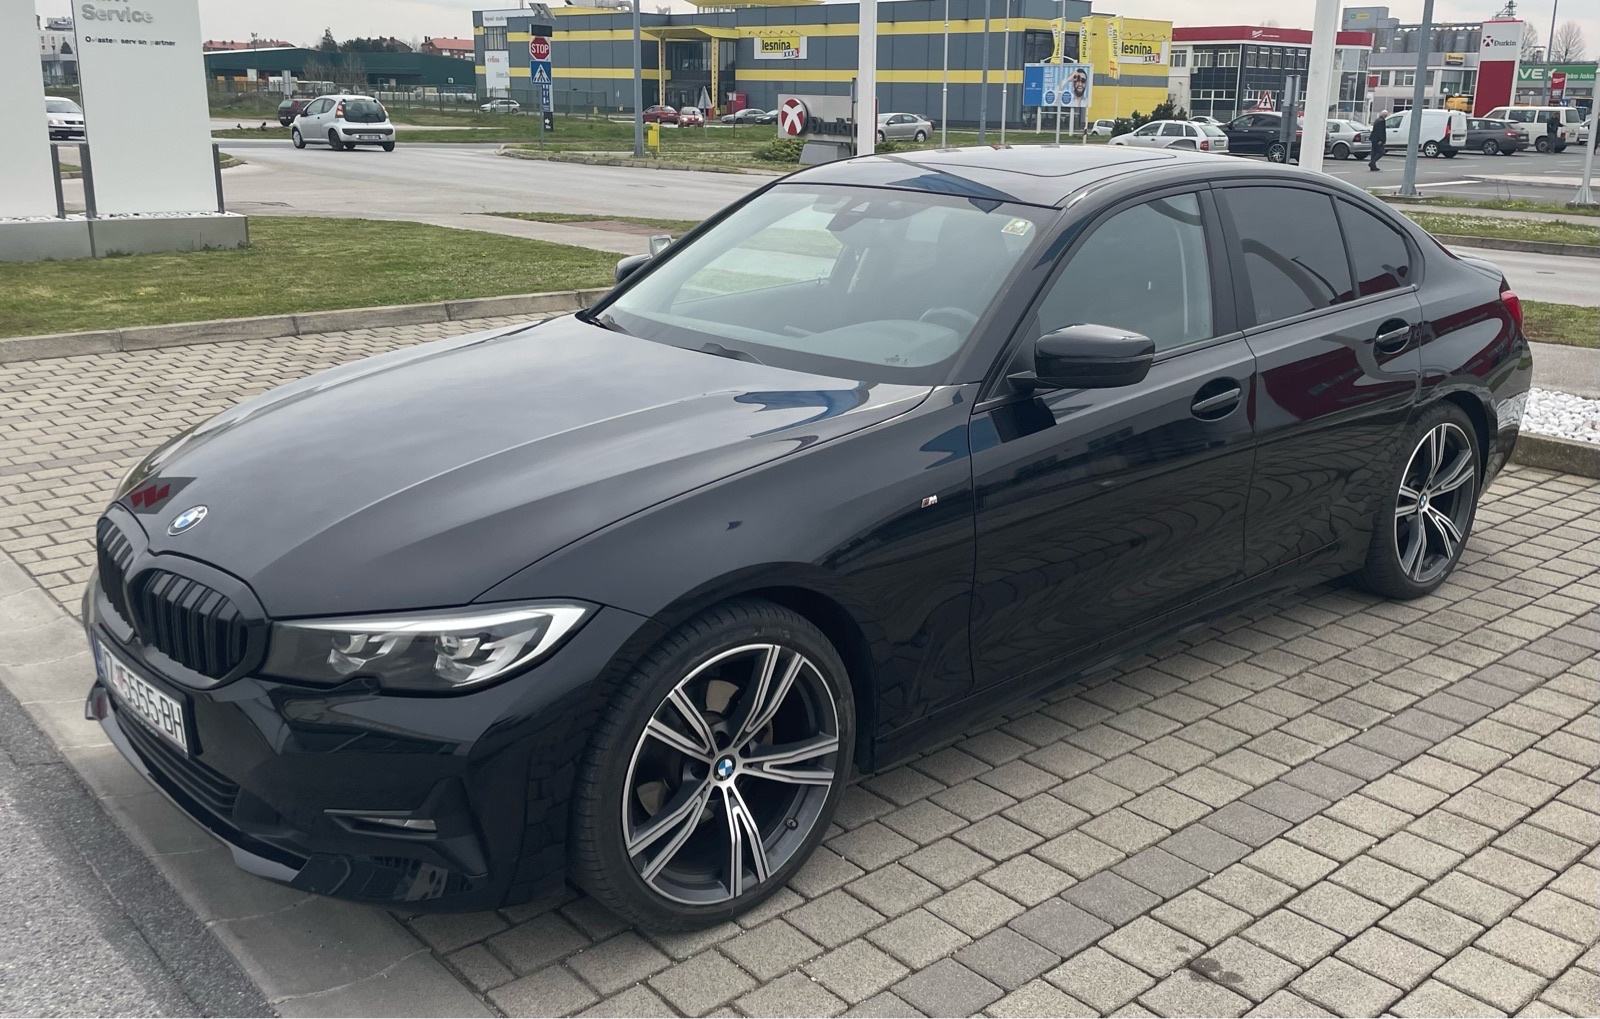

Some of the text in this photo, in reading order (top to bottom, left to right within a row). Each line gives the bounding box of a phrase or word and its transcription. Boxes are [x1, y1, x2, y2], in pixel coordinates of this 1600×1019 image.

[82, 4, 154, 23] Service
[531, 43, 550, 54] STOP
[761, 40, 791, 51] lesnina
[1121, 41, 1153, 55] lesnina
